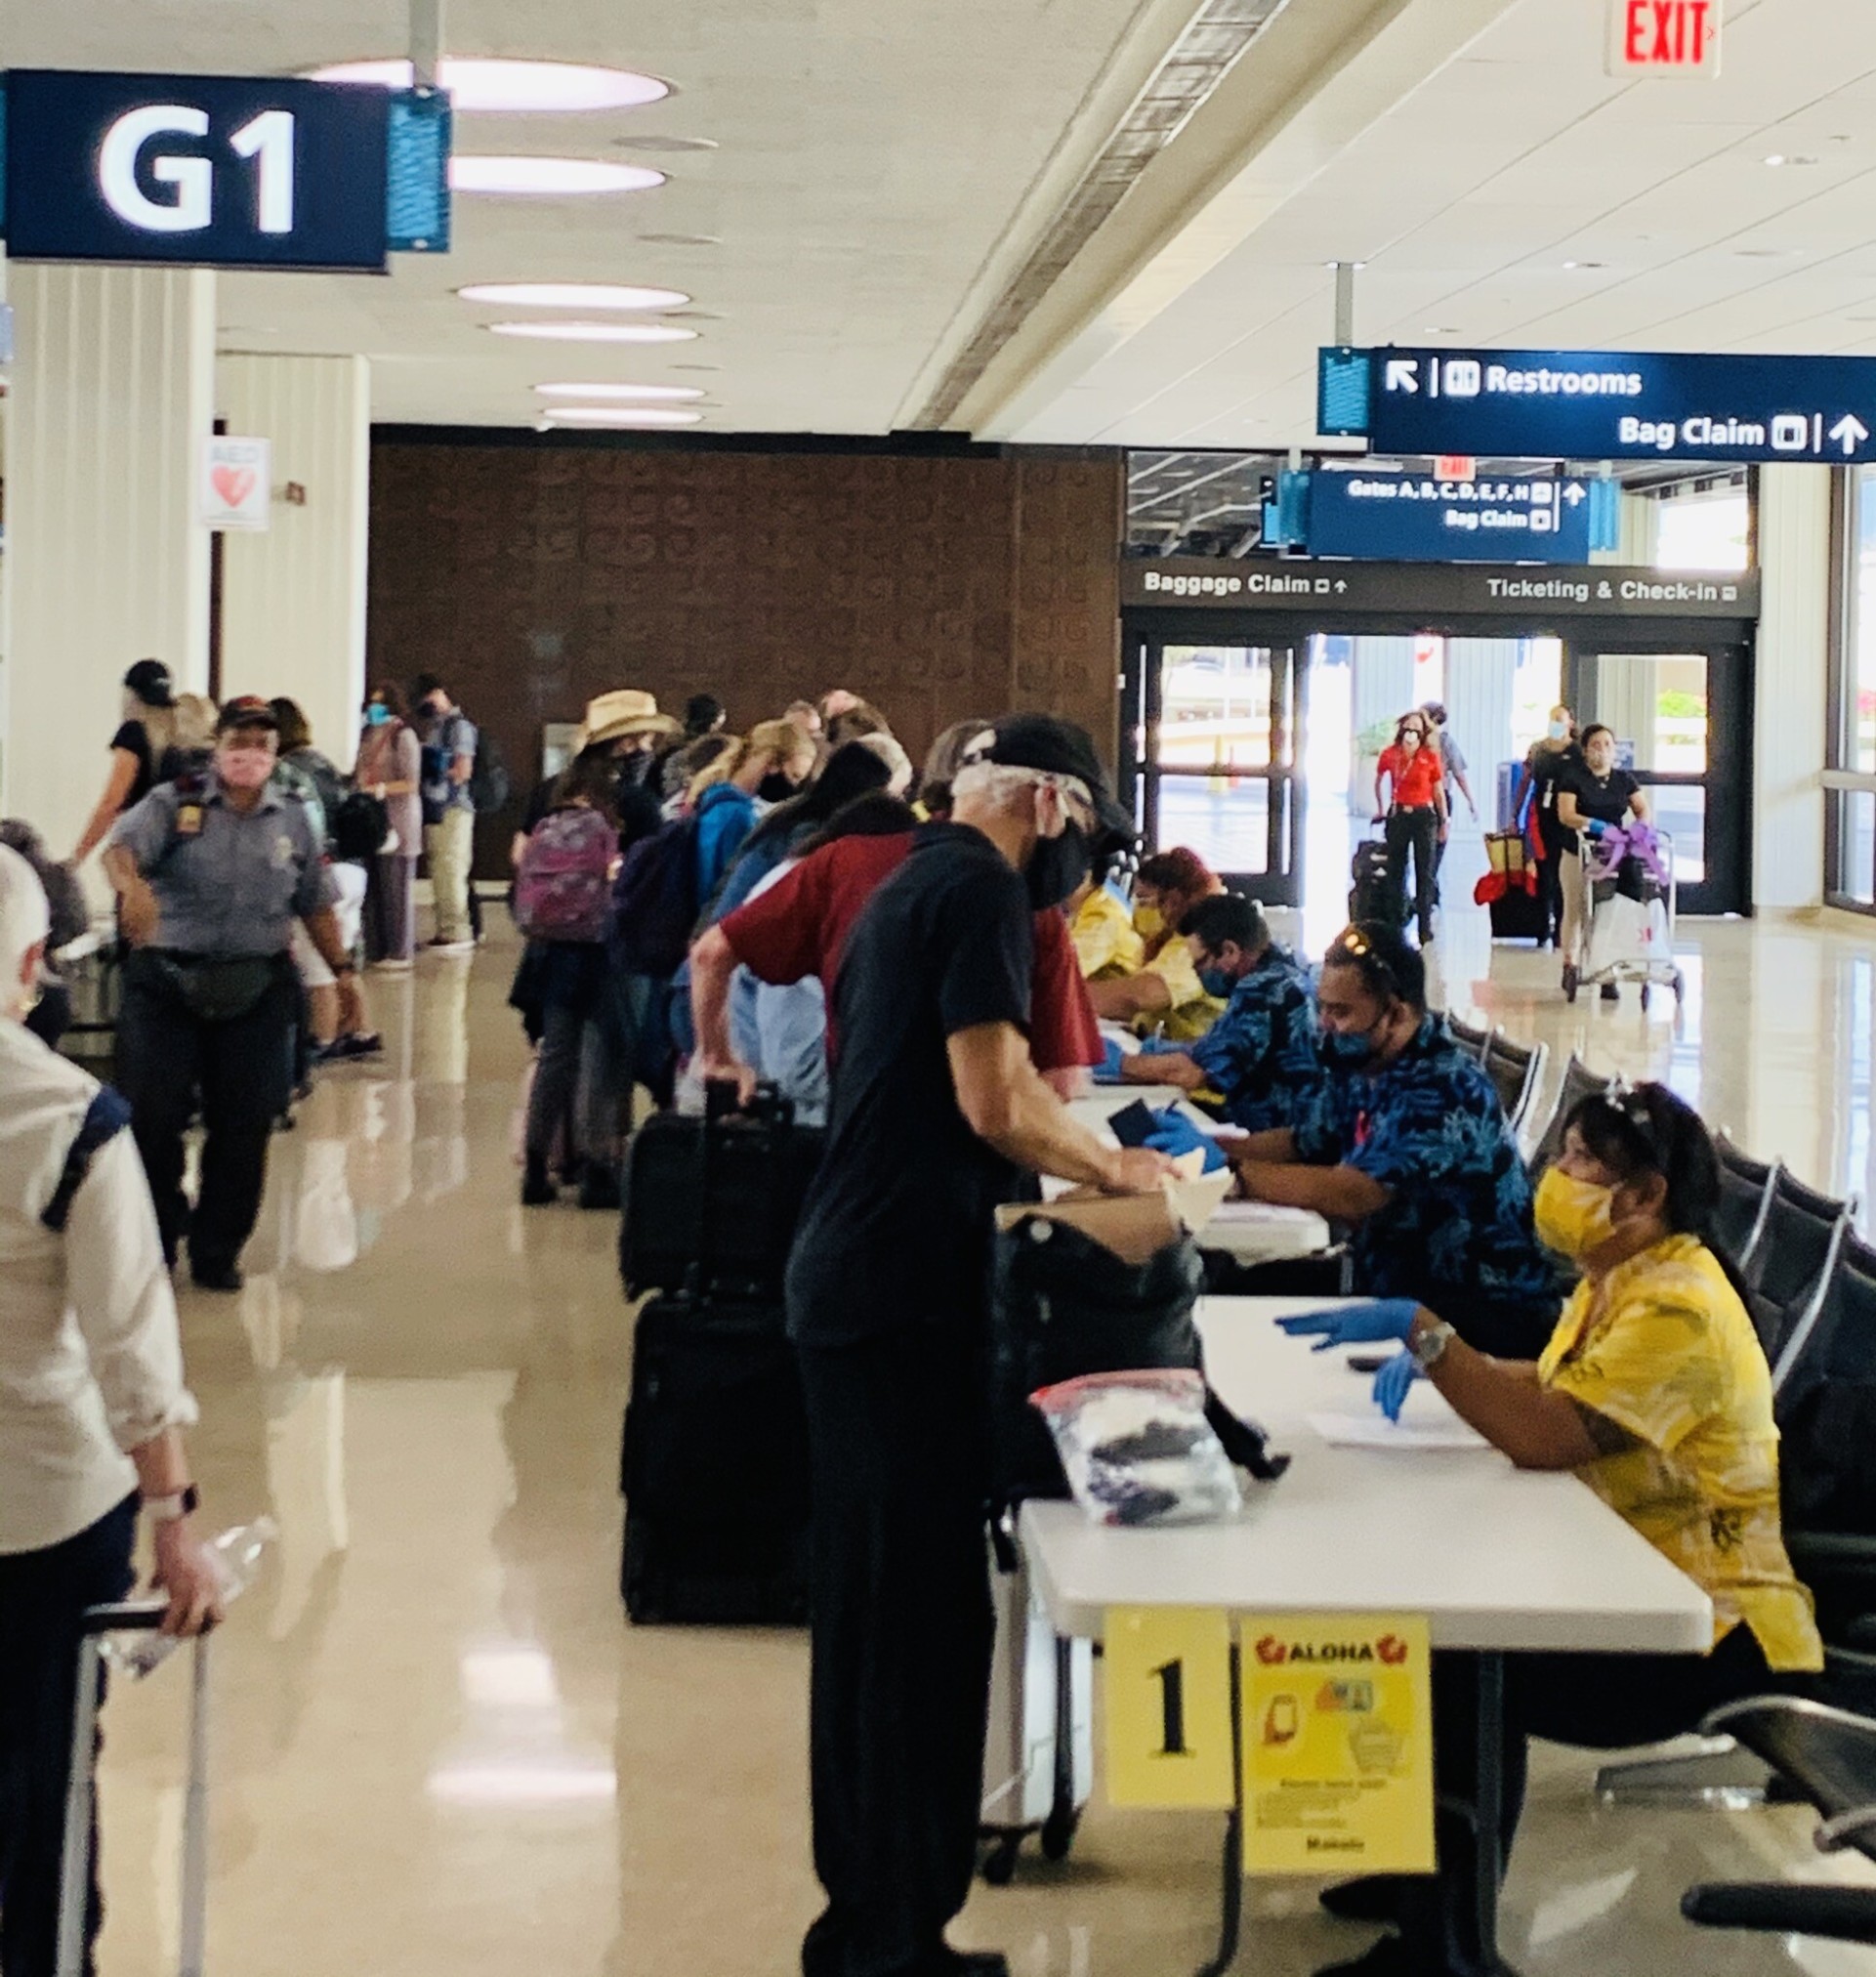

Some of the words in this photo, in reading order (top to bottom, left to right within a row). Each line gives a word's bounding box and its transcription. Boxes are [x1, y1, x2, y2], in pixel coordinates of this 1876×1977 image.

[1625, 0, 1709, 64] EXIT
[98, 104, 295, 234] G1
[1485, 364, 1644, 397] Restrooms
[1619, 415, 1677, 450] Bag
[1682, 416, 1765, 446] Claim
[1348, 479, 1397, 498] Gates
[1445, 509, 1479, 530] Bag
[1480, 509, 1528, 528] Claim
[1144, 571, 1242, 597] Baggage
[1247, 573, 1310, 594] Claim
[1486, 578, 1589, 603] Ticketing
[1596, 580, 1612, 600] &
[1620, 579, 1718, 601] Check-in
[1289, 1642, 1374, 1662] ALOHA
[1146, 1656, 1197, 1760] 1
